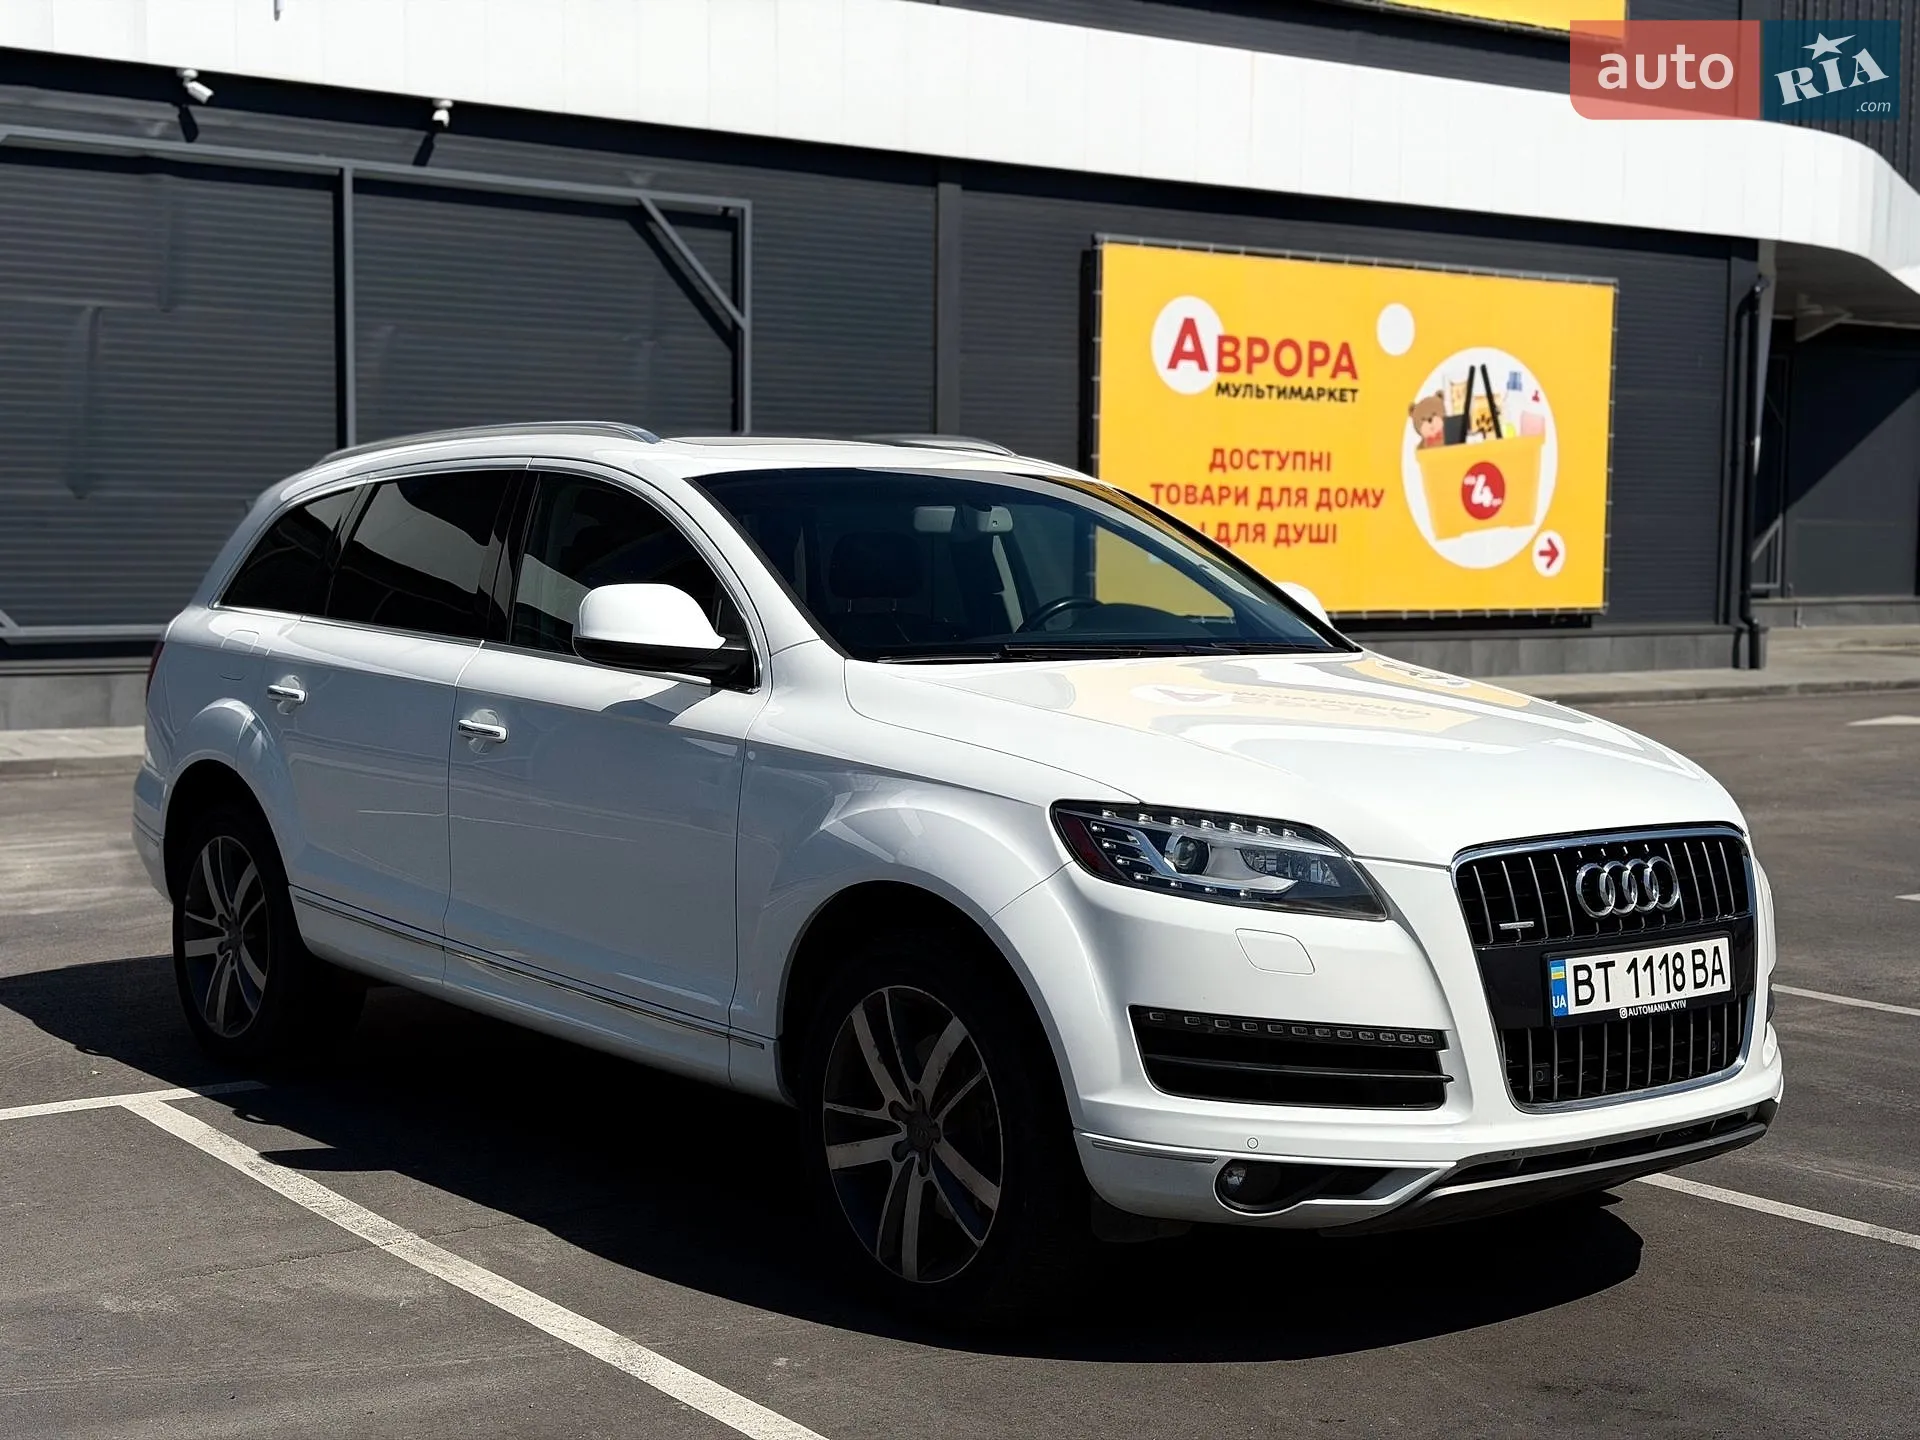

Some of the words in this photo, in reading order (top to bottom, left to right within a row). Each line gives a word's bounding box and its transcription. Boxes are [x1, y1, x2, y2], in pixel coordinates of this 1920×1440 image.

[1167, 317, 1359, 380] АВРОРА
[1216, 382, 1359, 402] МУЛЬТИМАРКЕТ
[1209, 448, 1331, 473] ДОСТУПНІ
[1150, 483, 1249, 507] ТОВАРИ
[1257, 486, 1308, 511] ДЛЯ
[1316, 487, 1384, 512] ДОМУ
[1216, 522, 1266, 548] ДЛЯ
[1274, 523, 1337, 548] ДУШІ
[1573, 960, 1616, 1007] BT
[1626, 951, 1686, 999] 1118
[1691, 945, 1726, 990] BA
[1552, 994, 1567, 1009] UA
